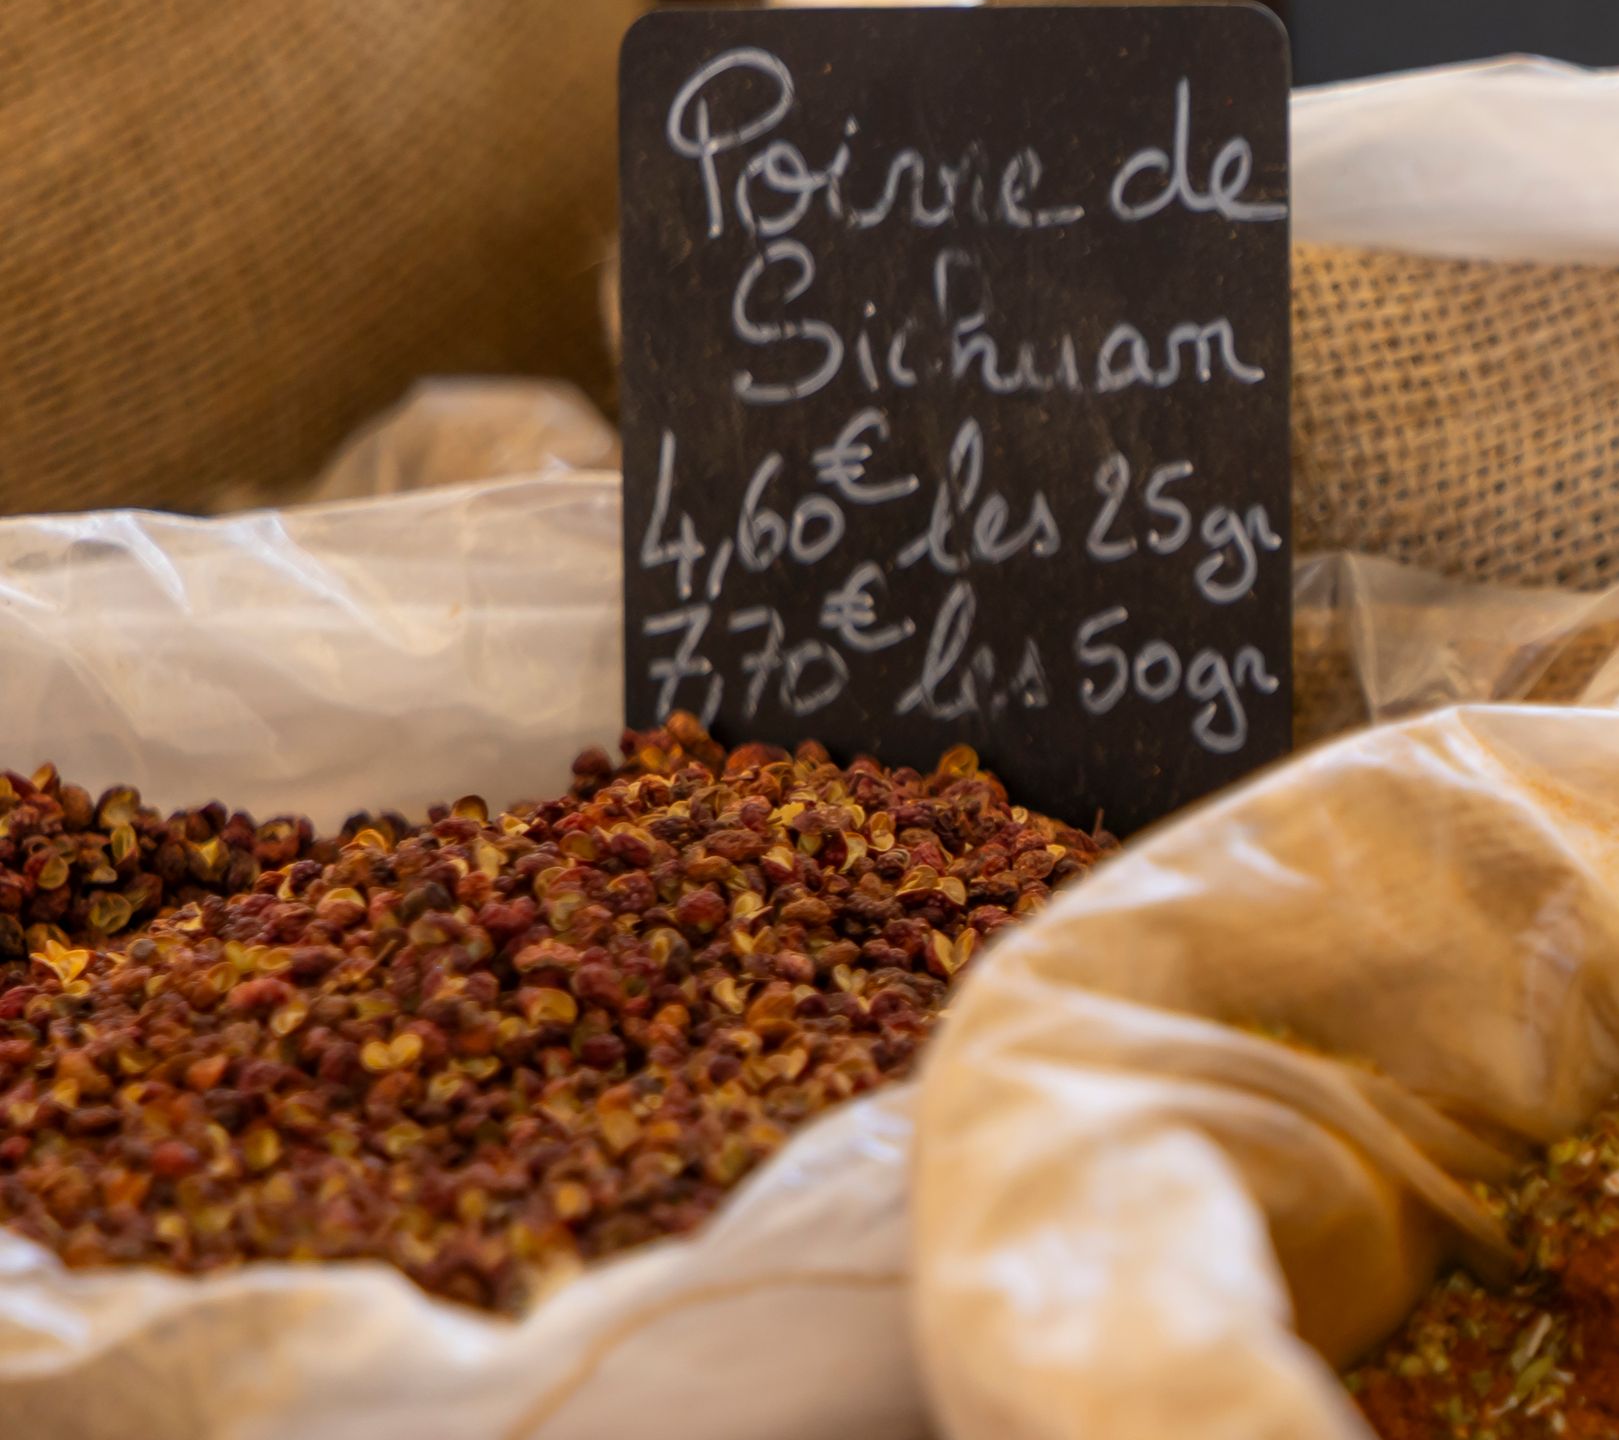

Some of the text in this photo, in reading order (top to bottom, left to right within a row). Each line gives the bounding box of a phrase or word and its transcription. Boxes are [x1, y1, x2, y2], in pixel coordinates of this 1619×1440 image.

[665, 44, 1291, 239] Poivre de
[638, 406, 1284, 605] 4,60€ les 25gr
[640, 564, 918, 729] 7,70€
[1073, 605, 1281, 754] 50gr
